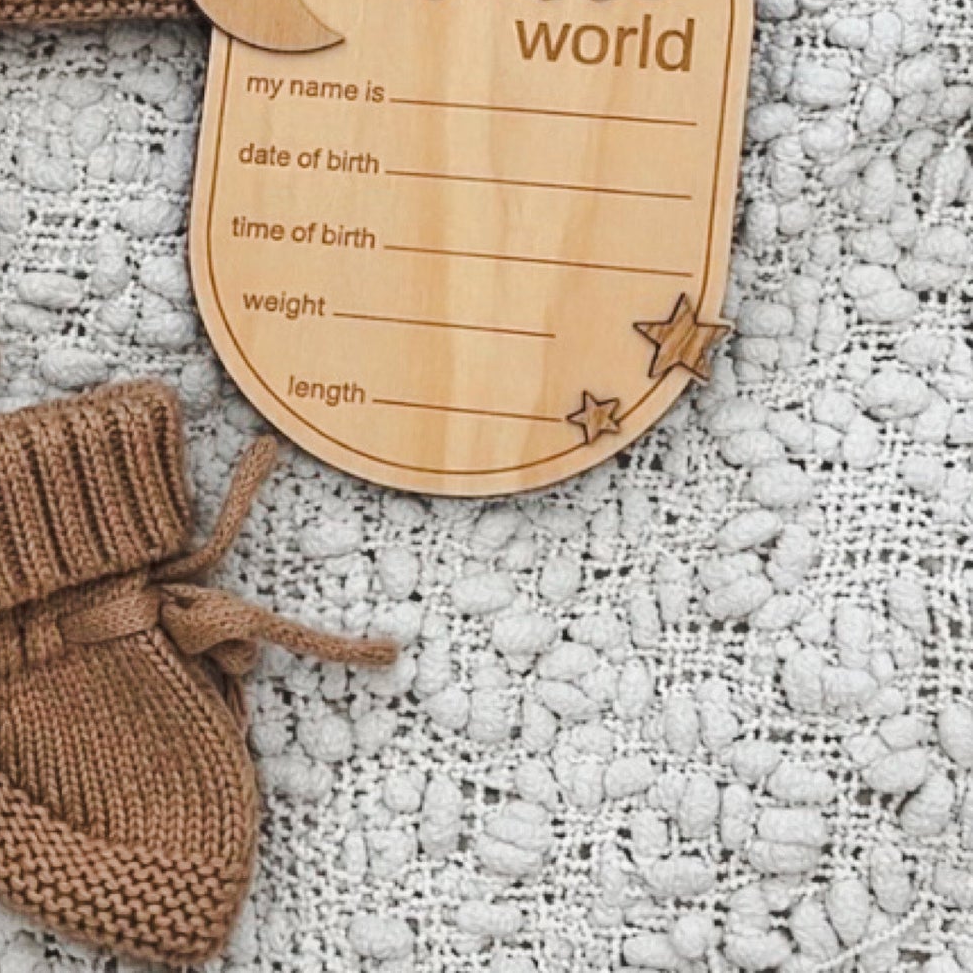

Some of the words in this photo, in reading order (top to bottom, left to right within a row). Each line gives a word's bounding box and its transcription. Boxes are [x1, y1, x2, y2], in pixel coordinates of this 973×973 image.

[514, 13, 696, 72] world
[246, 74, 282, 99] my
[290, 80, 359, 101] name
[365, 81, 385, 104] is
[238, 143, 291, 168] date
[297, 148, 323, 170] of
[326, 150, 380, 174] birth
[231, 216, 285, 242] time
[292, 221, 317, 244] of
[321, 222, 376, 249] birth
[242, 291, 326, 320] weight
[287, 375, 366, 406] length
